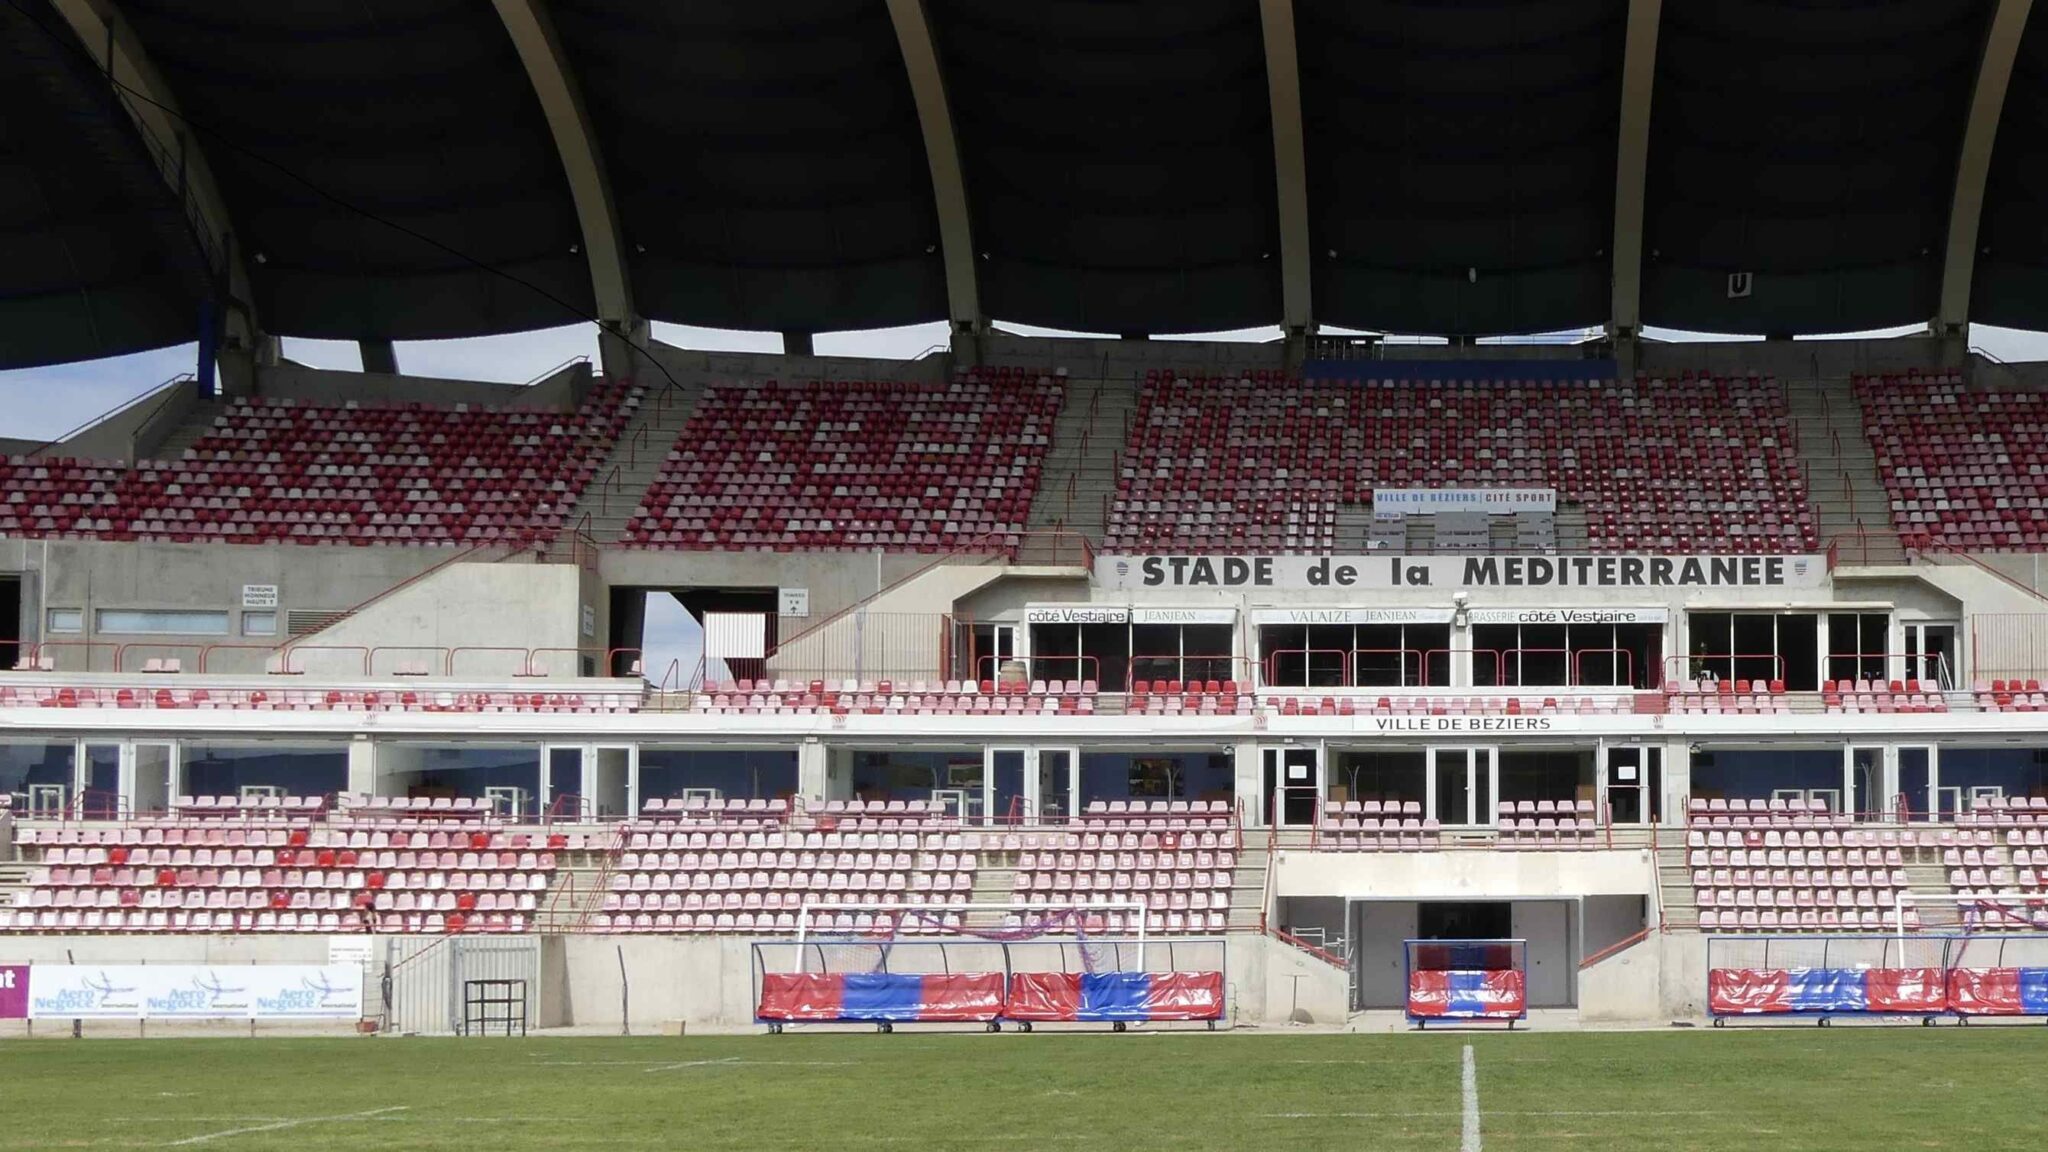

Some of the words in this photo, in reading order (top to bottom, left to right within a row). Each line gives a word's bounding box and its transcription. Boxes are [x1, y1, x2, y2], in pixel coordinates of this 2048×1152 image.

[1377, 493, 1406, 503] VILLE
[1412, 493, 1425, 503] DE
[1485, 491, 1510, 503] CITÉ
[1516, 493, 1552, 503] SPORT
[1143, 557, 1273, 586] STADE
[1307, 557, 1358, 586] de
[1392, 557, 1429, 586] la
[1463, 557, 1784, 586] MEDITERRANEE
[1028, 609, 1059, 623] côté
[1062, 610, 1125, 623] Vestiaire
[1144, 611, 1196, 621] JEANJEAN
[1290, 611, 1350, 622] VALAIZE
[1365, 610, 1417, 621] JEANJEAN
[1469, 611, 1516, 622] BRASSERIE
[1518, 610, 1556, 622] côté
[1561, 610, 1637, 623] Vestiaire
[1377, 718, 1431, 730] VILLE
[1438, 718, 1462, 730] DE
[59, 988, 95, 999] Aero
[169, 988, 206, 1000] Aero
[280, 988, 315, 999] Aero
